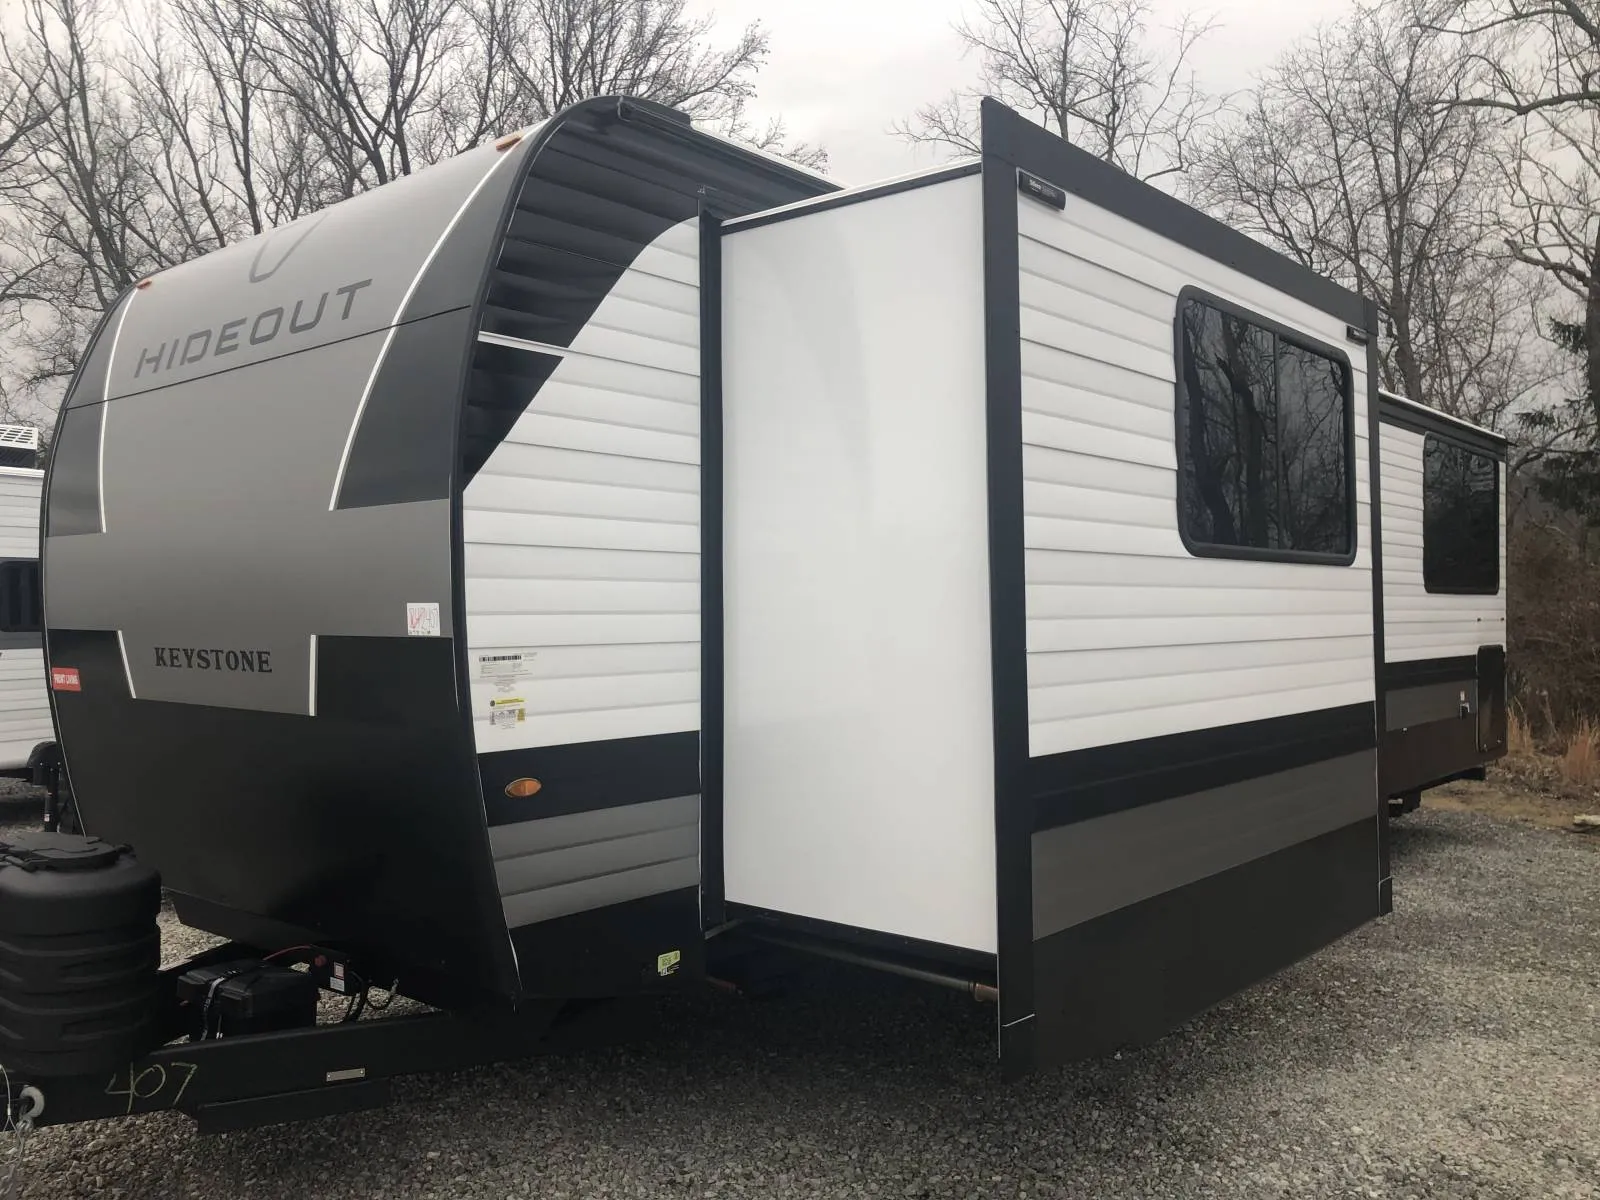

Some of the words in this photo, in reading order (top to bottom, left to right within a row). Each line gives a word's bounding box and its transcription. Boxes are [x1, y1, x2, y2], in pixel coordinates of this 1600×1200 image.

[134, 278, 373, 379] HIDEOUT
[153, 646, 273, 673] KEYSTONE
[104, 1062, 198, 1114] 407
